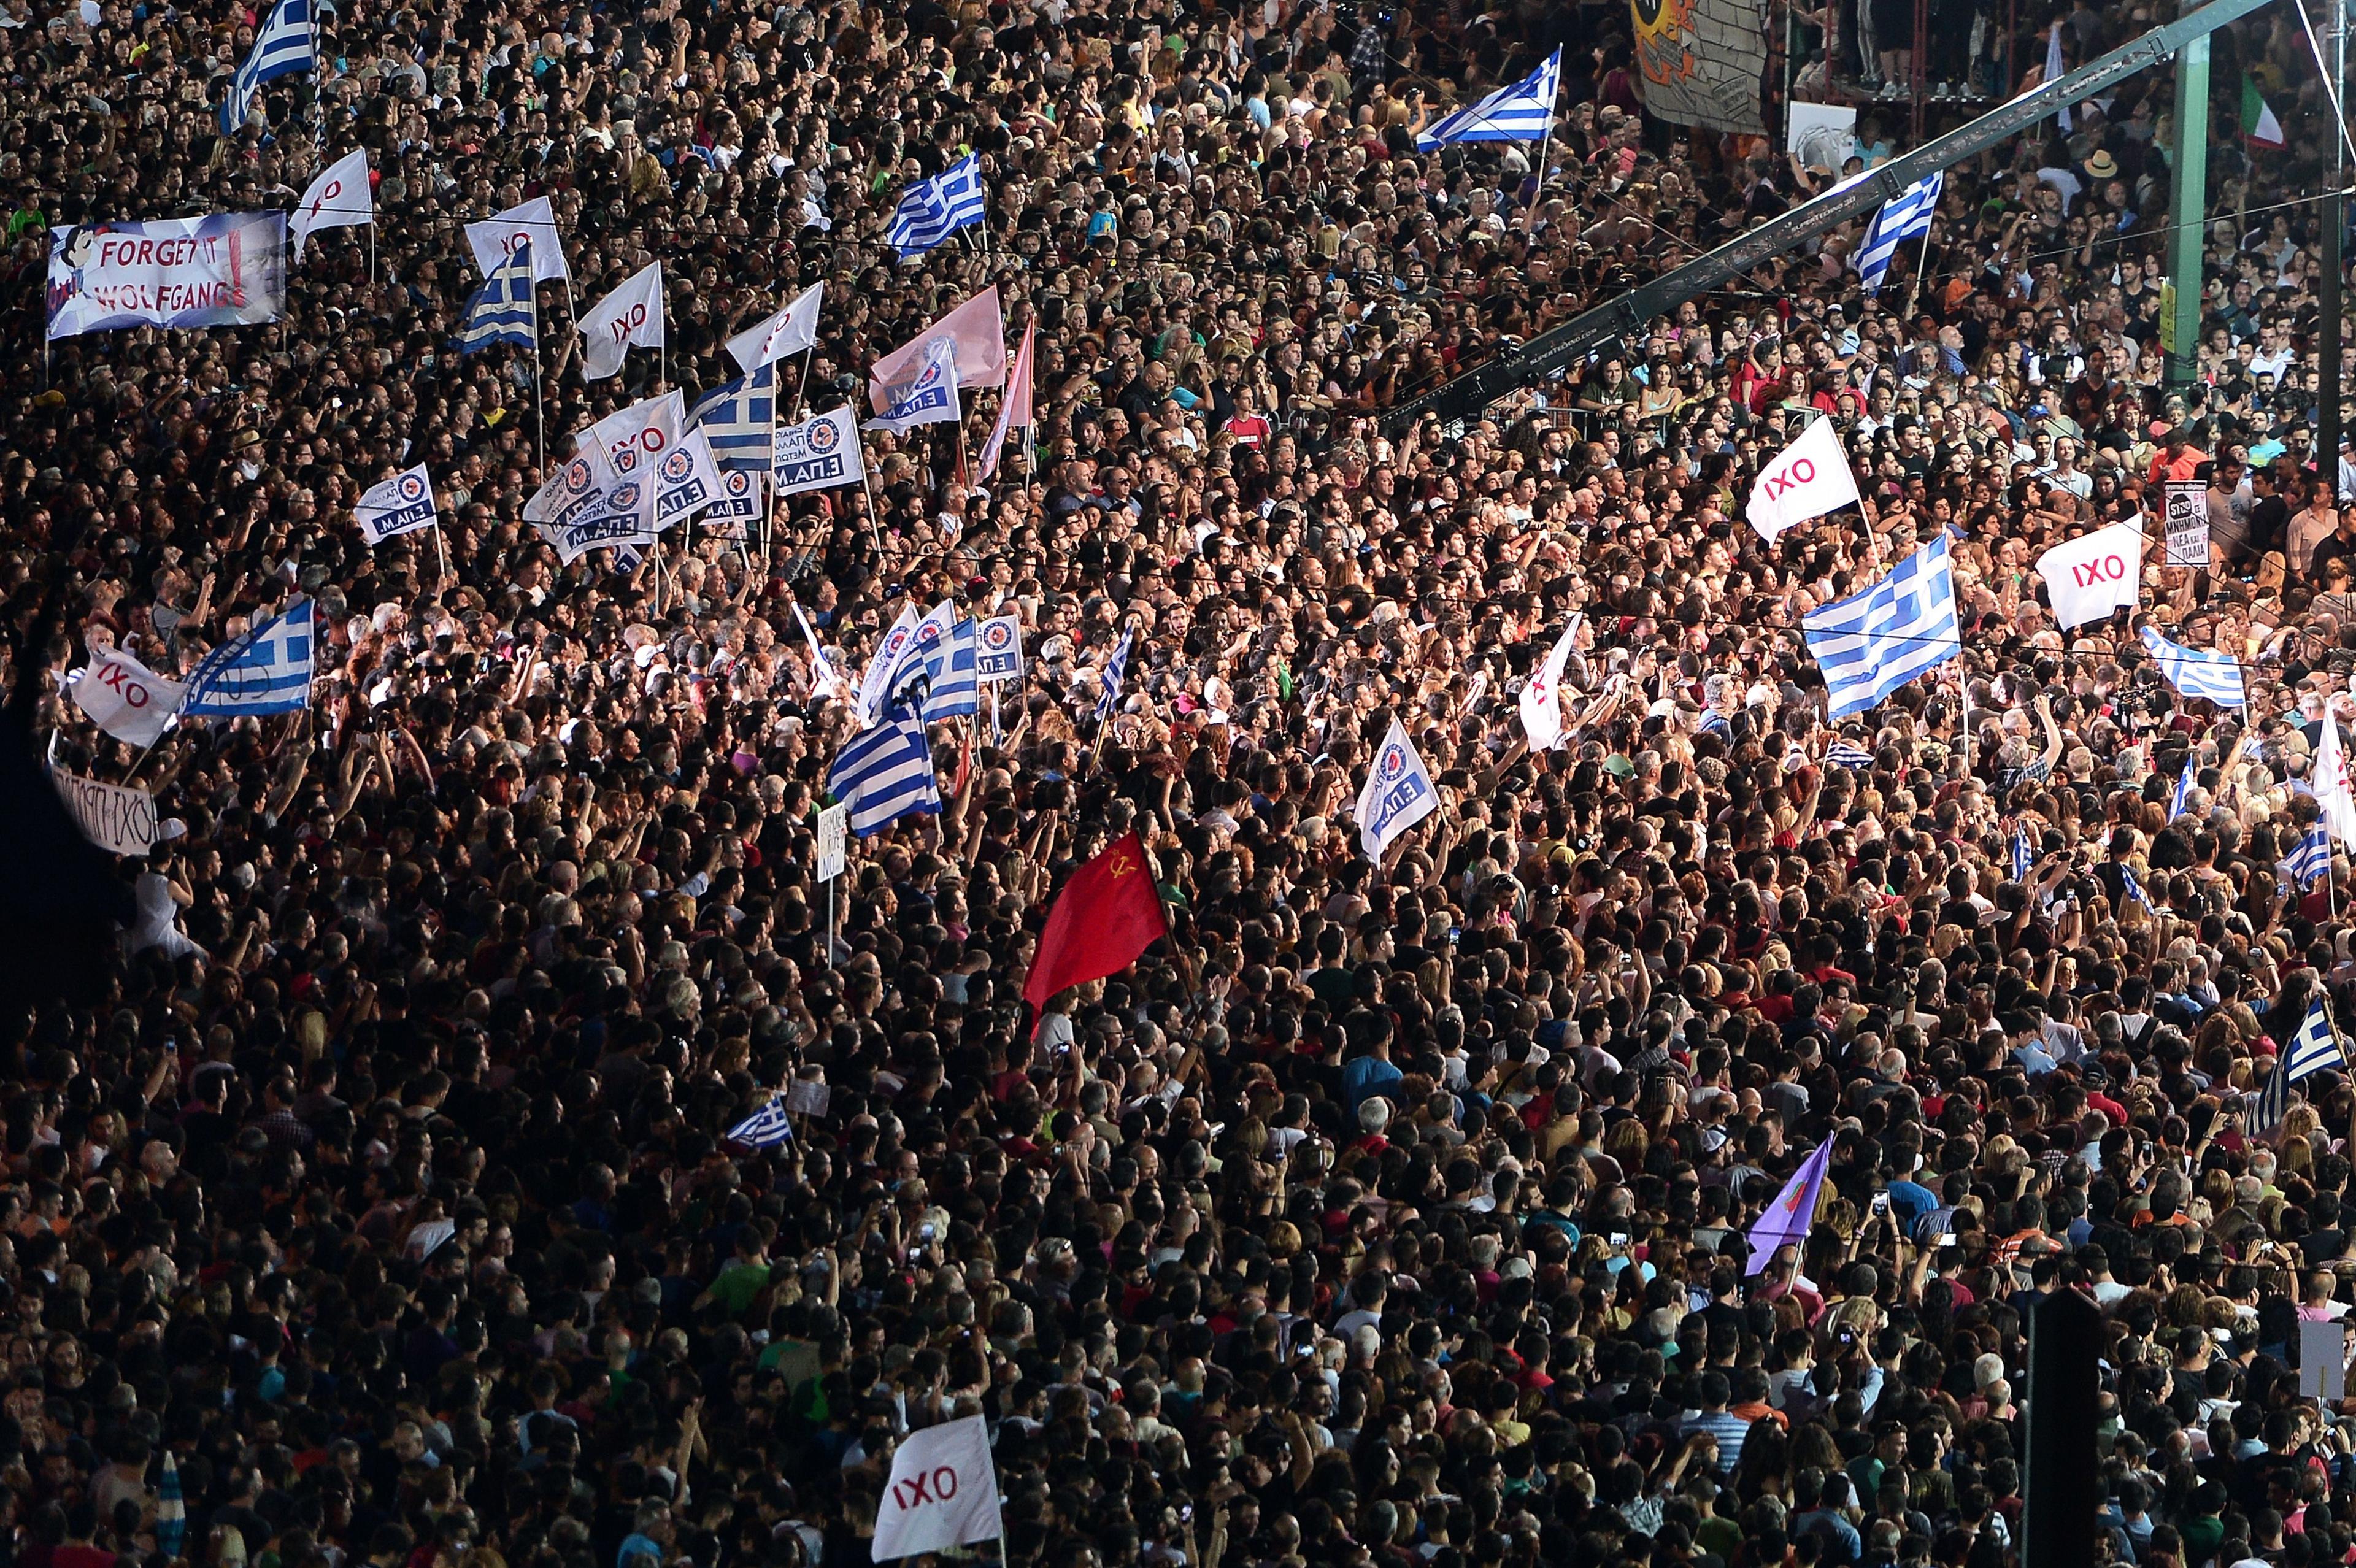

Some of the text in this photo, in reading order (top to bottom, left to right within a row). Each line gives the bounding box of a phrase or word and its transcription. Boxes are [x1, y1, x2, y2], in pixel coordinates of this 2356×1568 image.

[204, 236, 217, 264] IT
[94, 281, 228, 313] WOLFGANG
[2173, 534, 2190, 548] ΝΕΑ
[2182, 543, 2206, 560] ΠΑΛΙΑ
